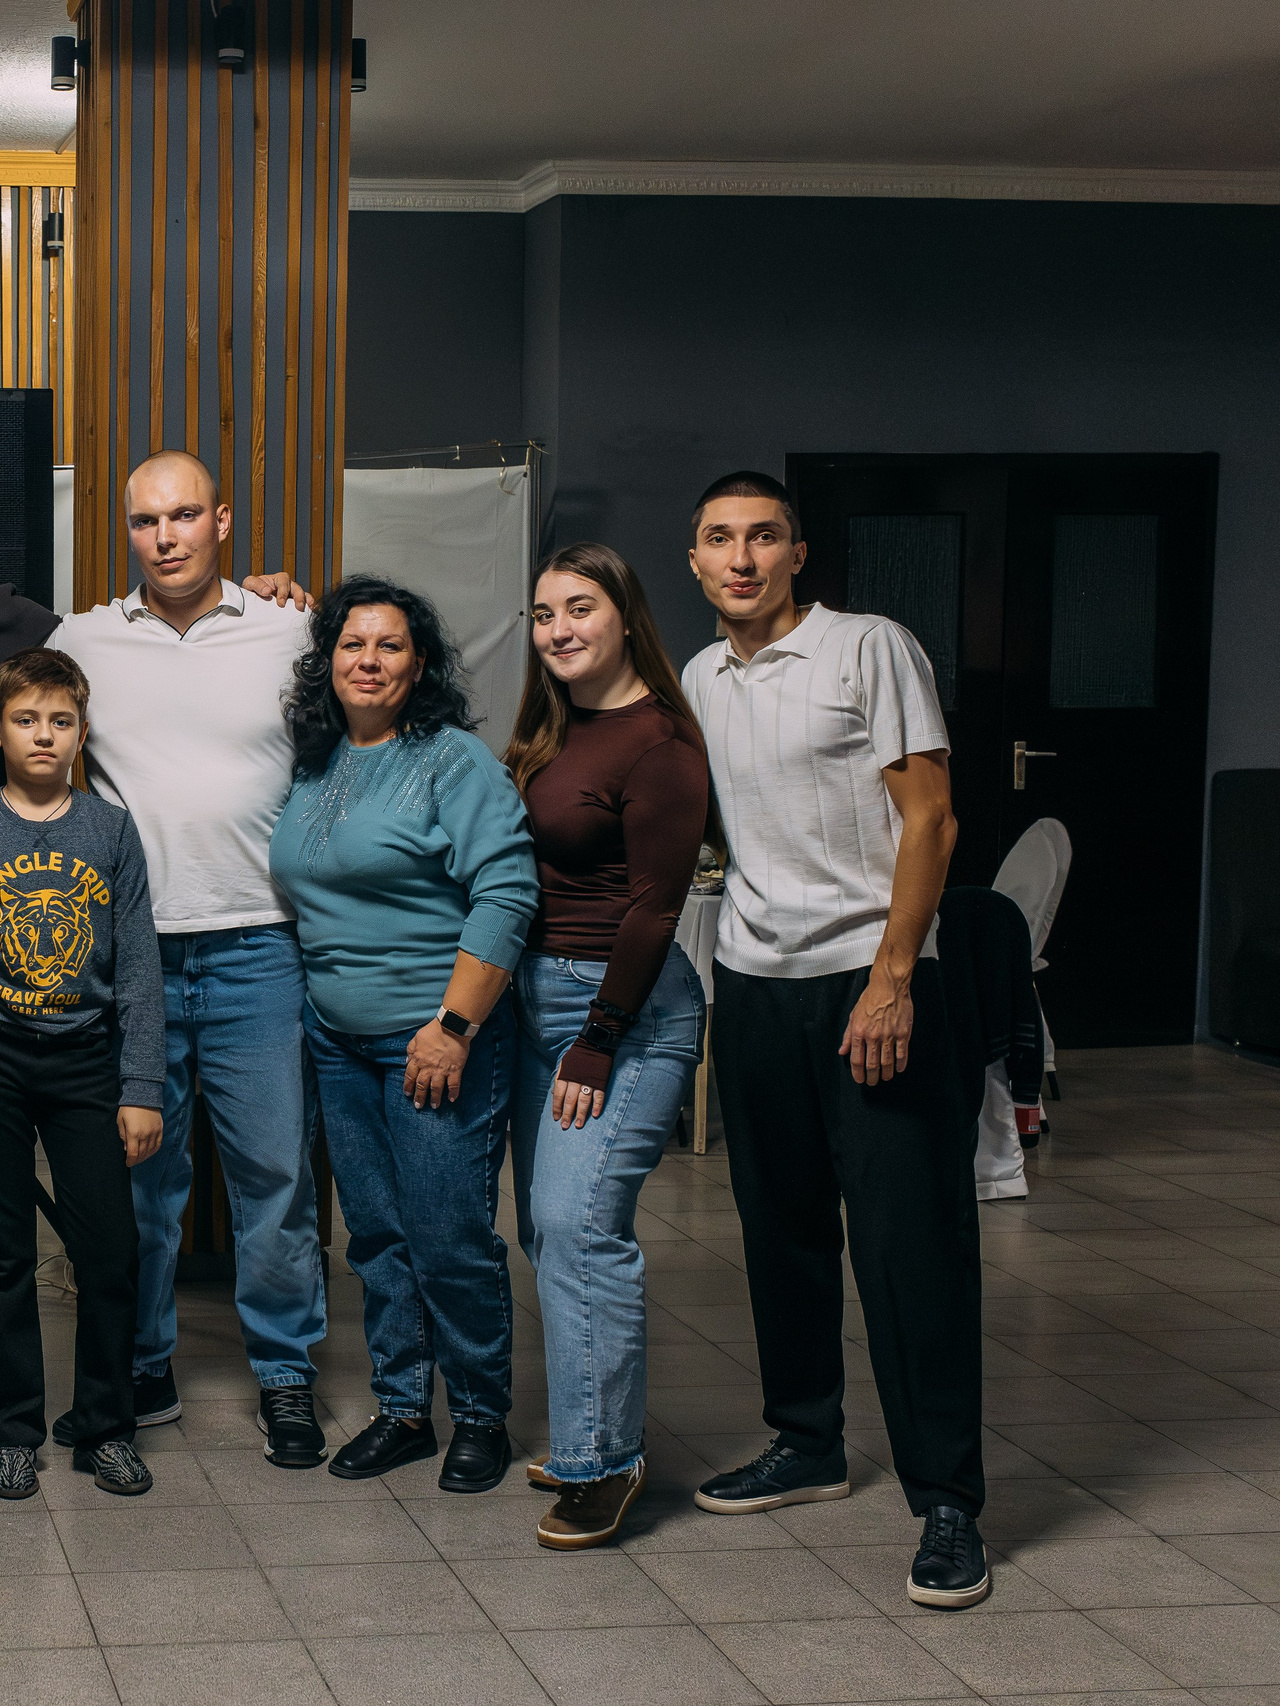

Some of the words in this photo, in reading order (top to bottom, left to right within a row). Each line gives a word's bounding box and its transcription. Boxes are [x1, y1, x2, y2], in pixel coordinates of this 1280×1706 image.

[70, 858, 110, 906] TRIP
[47, 993, 81, 1006] SOUL
[42, 1006, 64, 1015] HERE
